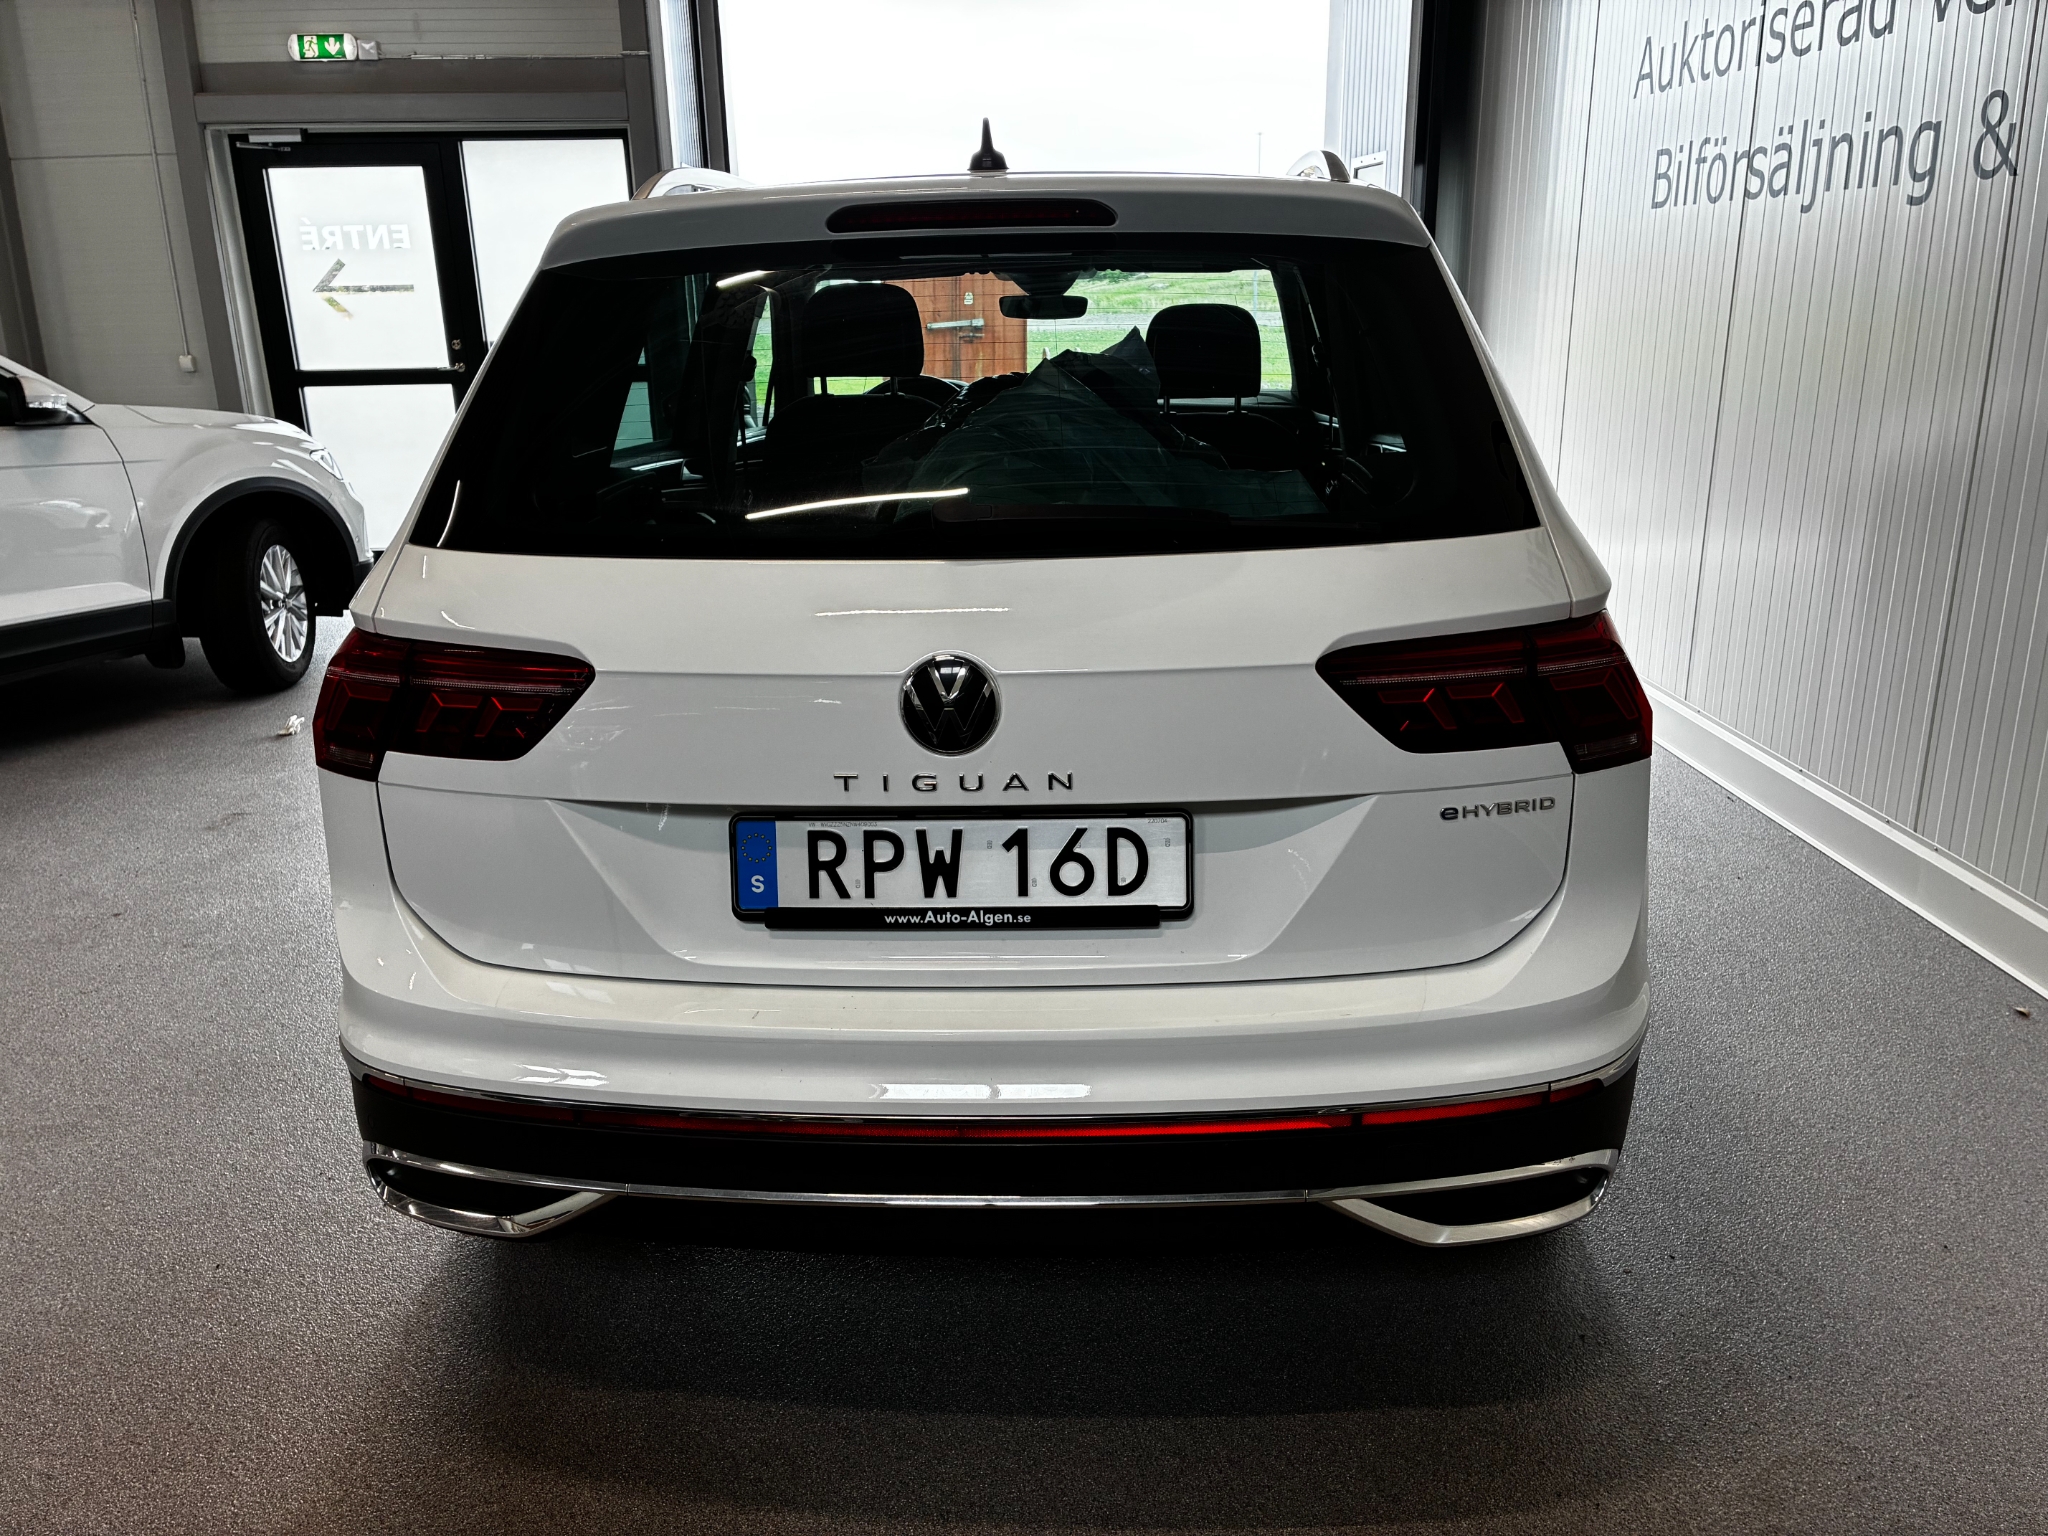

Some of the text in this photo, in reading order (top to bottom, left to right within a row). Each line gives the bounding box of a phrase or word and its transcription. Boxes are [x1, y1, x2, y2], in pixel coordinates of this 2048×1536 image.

[1651, 89, 2019, 214] Bilförsäljning &
[833, 772, 1073, 792] TIGUAN
[1440, 796, 1556, 820] eHYBRID
[807, 827, 1149, 899] RPW 16D
[751, 875, 765, 893] S
[884, 910, 1031, 926] www.Auto-Algen.se
